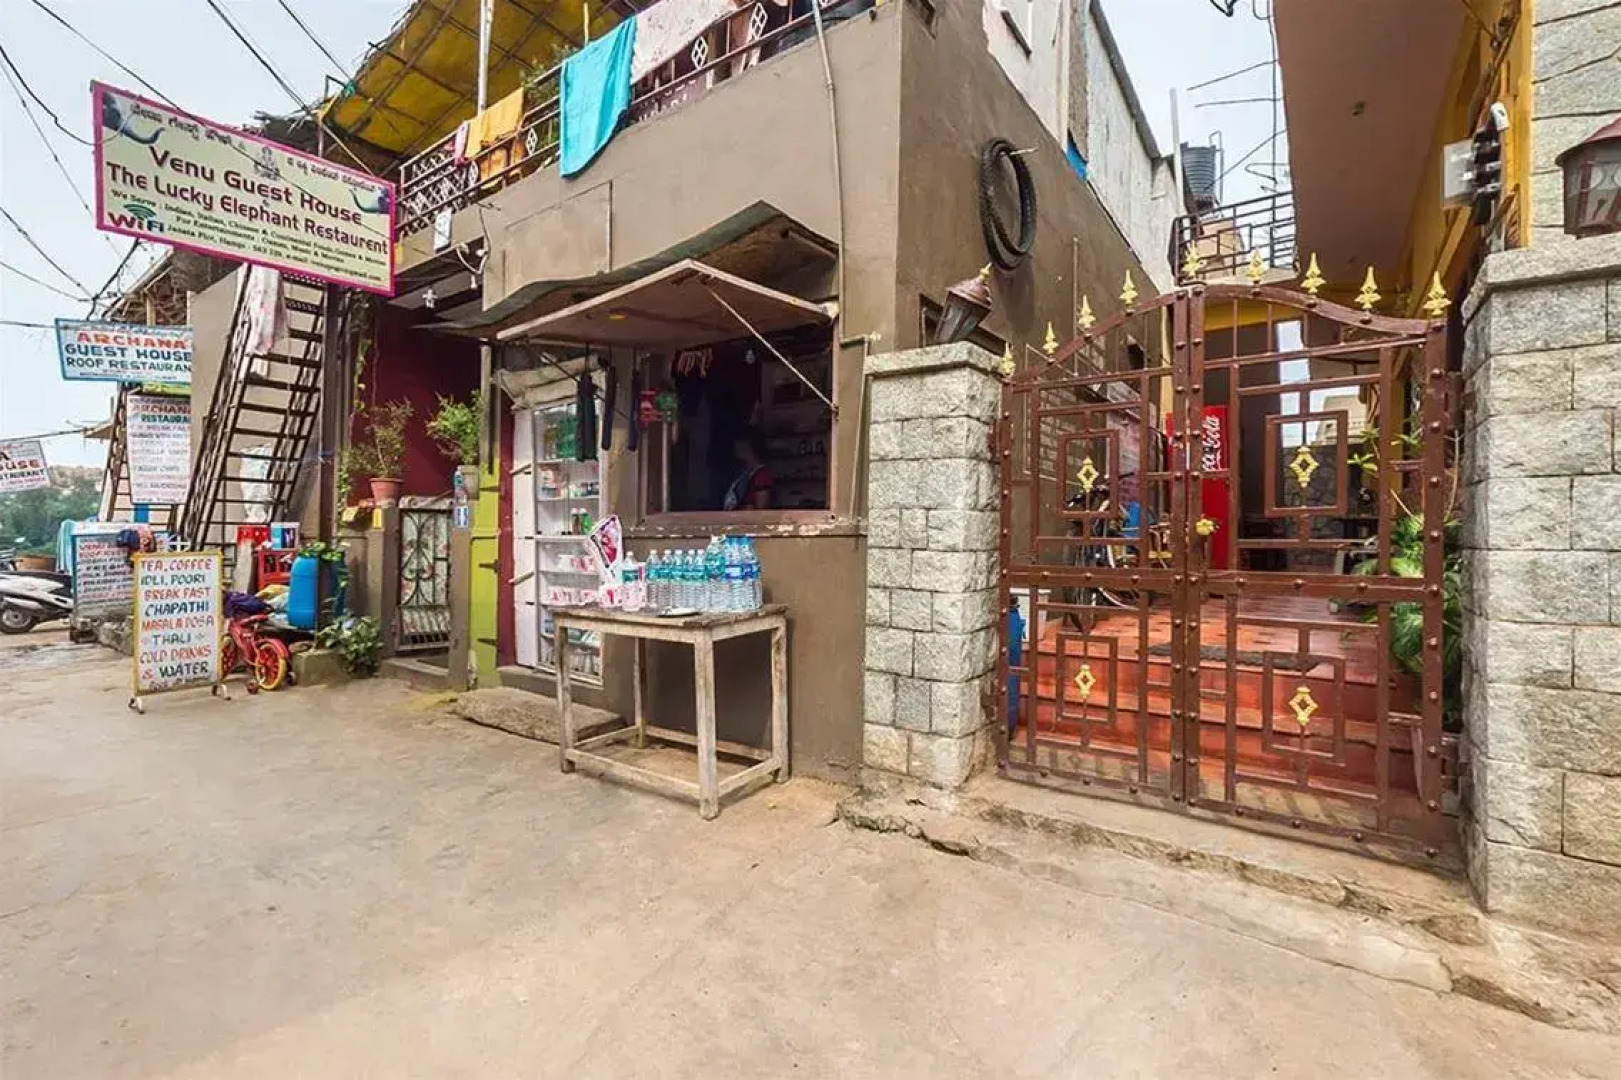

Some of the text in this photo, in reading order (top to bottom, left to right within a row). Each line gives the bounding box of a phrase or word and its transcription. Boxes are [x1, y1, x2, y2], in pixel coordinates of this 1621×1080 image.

[149, 145, 215, 183] Venu
[223, 169, 294, 207] Guest
[300, 191, 363, 226] House
[106, 161, 389, 255] The Lucky Elephant Restaurent
[77, 331, 186, 349] ARCHANA
[65, 343, 192, 362] GUEST HOUSE
[66, 356, 192, 372] ROOF RESTAURAN
[171, 573, 205, 585] POORI
[144, 588, 180, 601] BREAK
[183, 587, 211, 599] FAST
[145, 600, 209, 617] CHAPATHI
[153, 633, 191, 646] THALI
[140, 649, 167, 664] COLD
[159, 661, 208, 678] WATER
